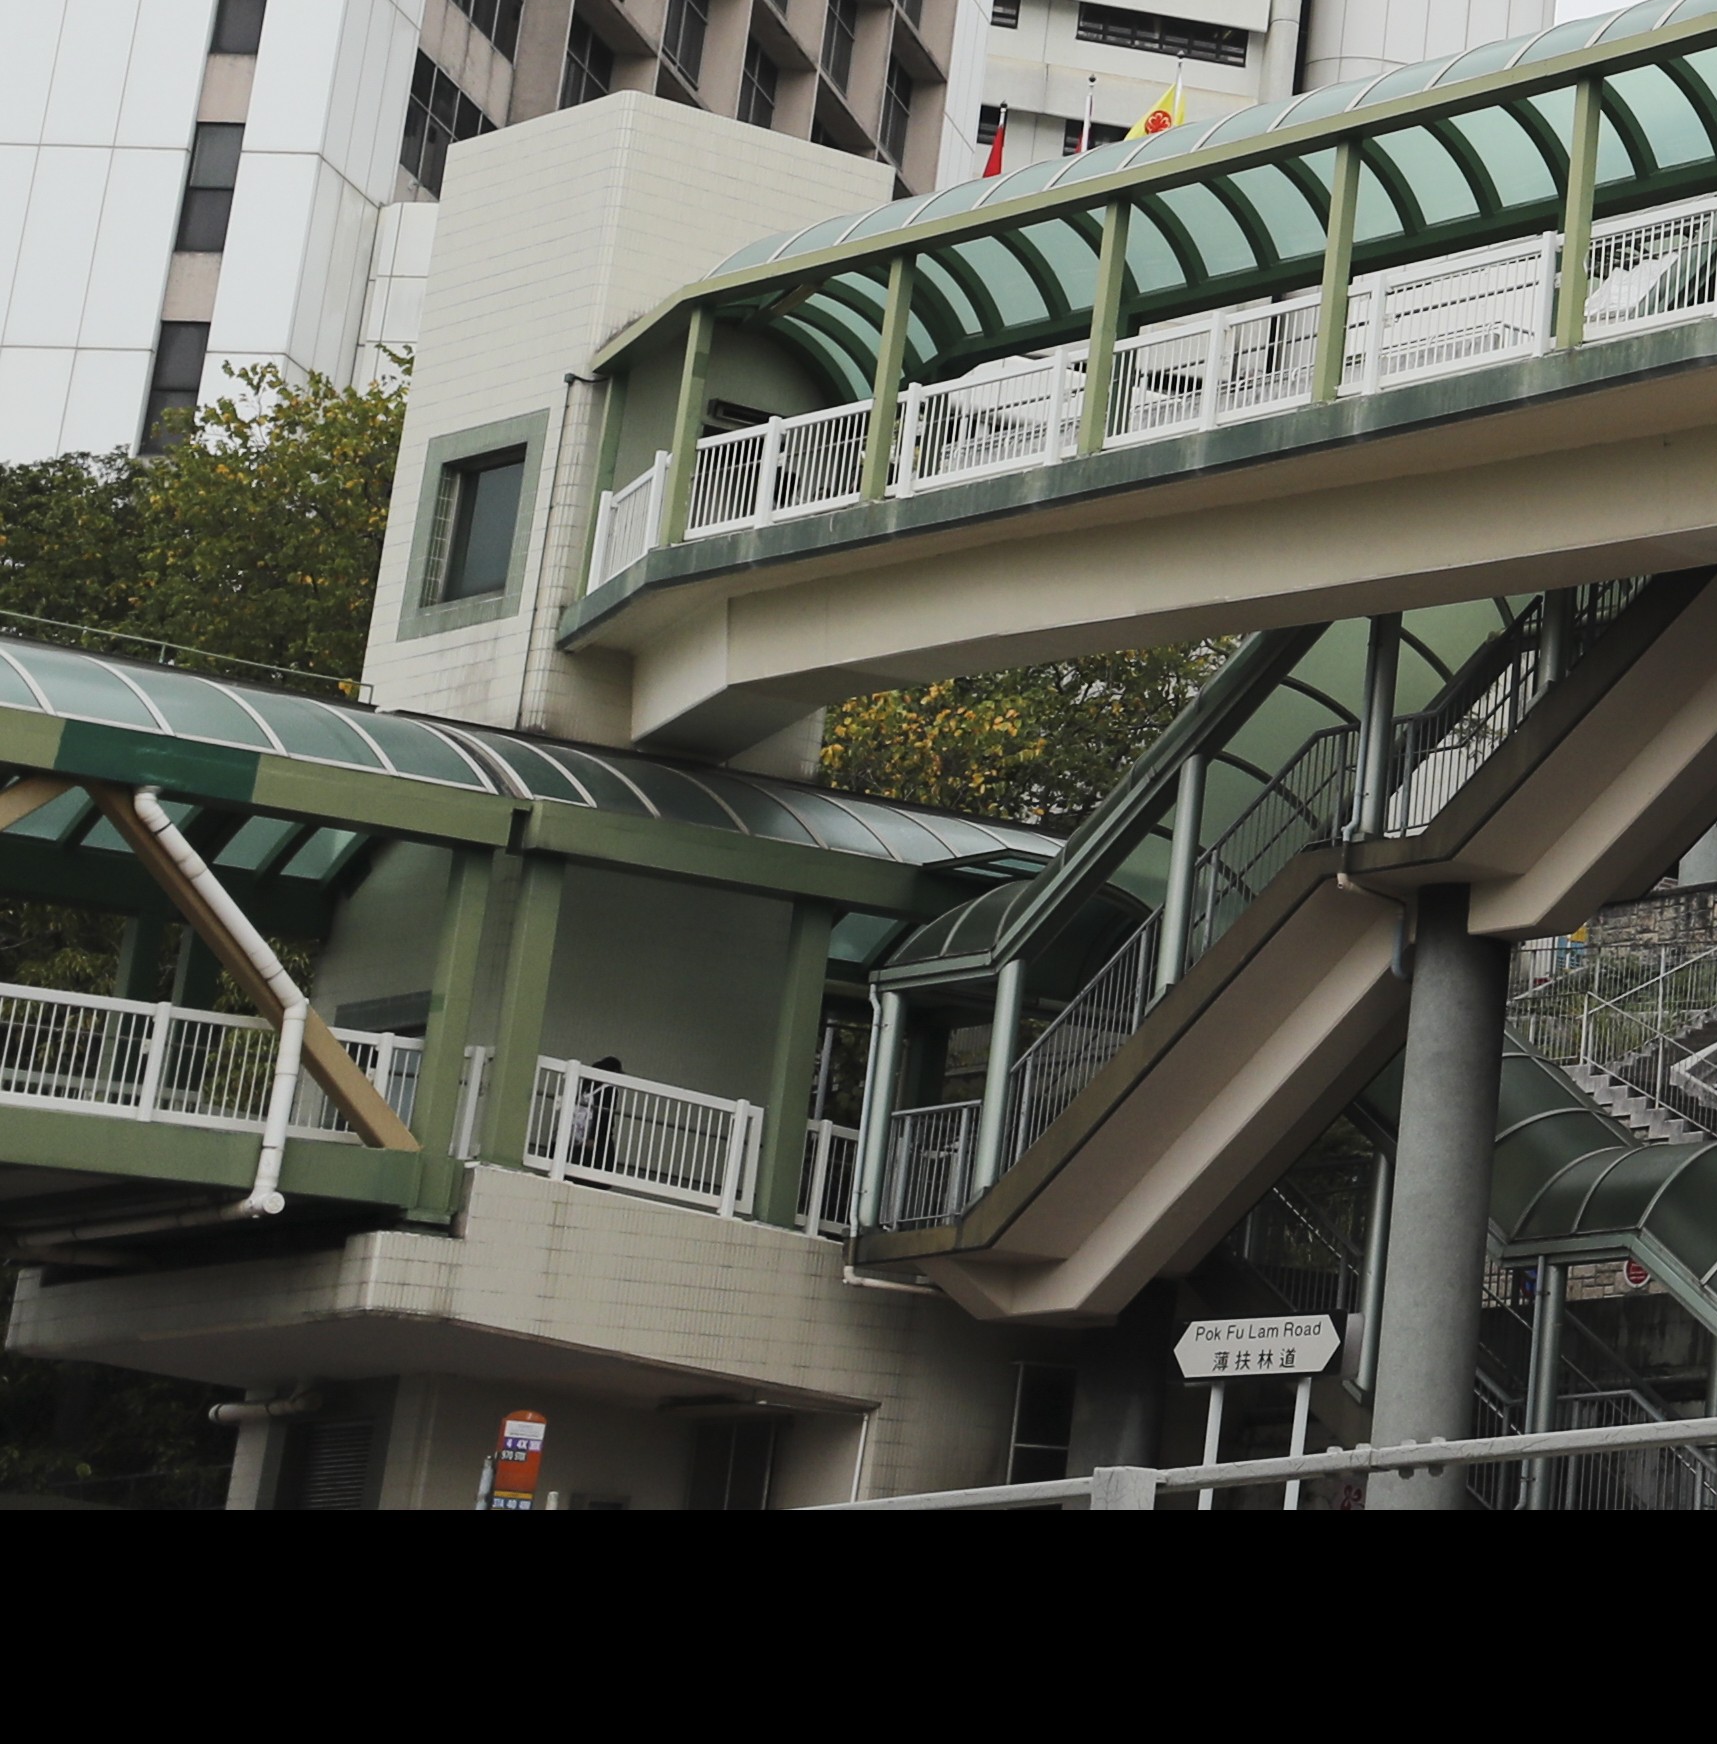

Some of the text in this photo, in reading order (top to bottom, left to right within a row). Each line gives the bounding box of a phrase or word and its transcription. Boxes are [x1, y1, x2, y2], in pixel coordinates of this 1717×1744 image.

[1195, 1321, 1322, 1342] Pok Fu Lam Road
[1212, 1347, 1297, 1372] 薄扶林道
